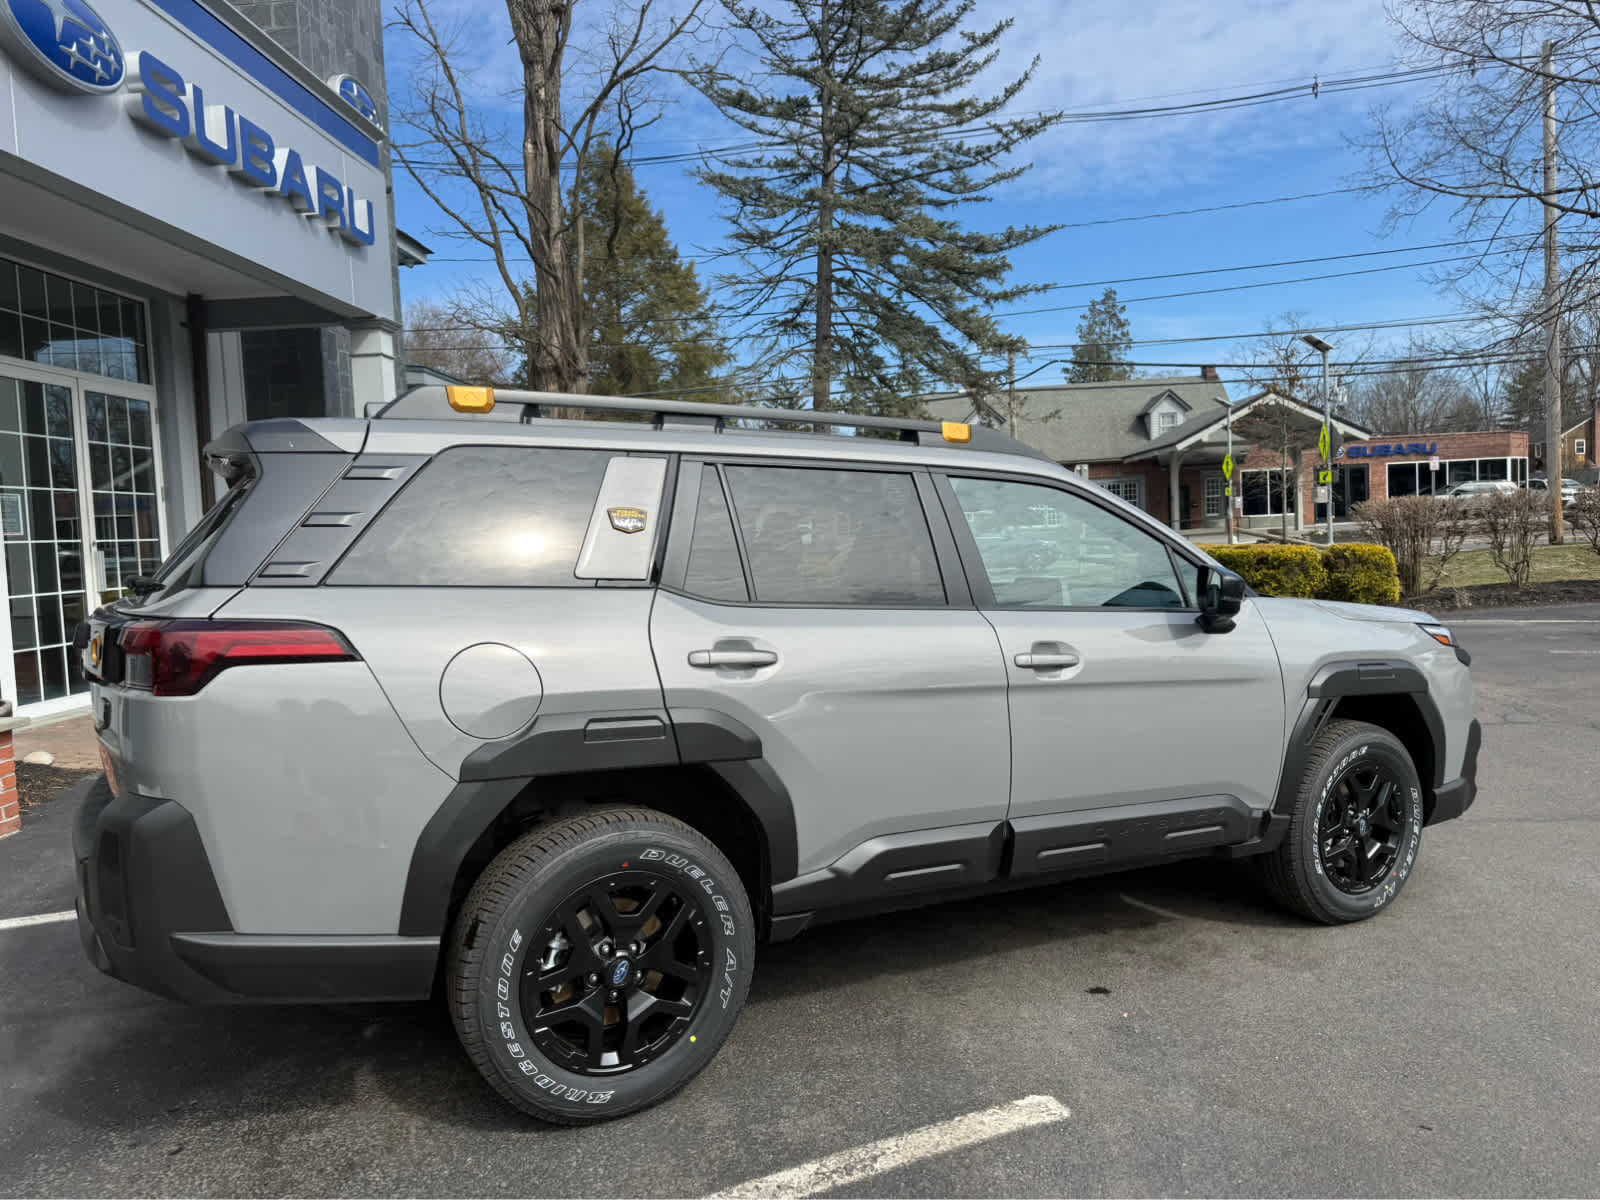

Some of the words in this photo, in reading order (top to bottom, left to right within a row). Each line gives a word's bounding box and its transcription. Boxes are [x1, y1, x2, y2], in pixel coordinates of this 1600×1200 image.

[138, 50, 375, 246] SUBARU
[1347, 442, 1438, 459] SUBARU
[639, 849, 735, 936] DUELER
[720, 947, 737, 1009] A/T
[497, 928, 616, 1104] BRIDGESTONE
